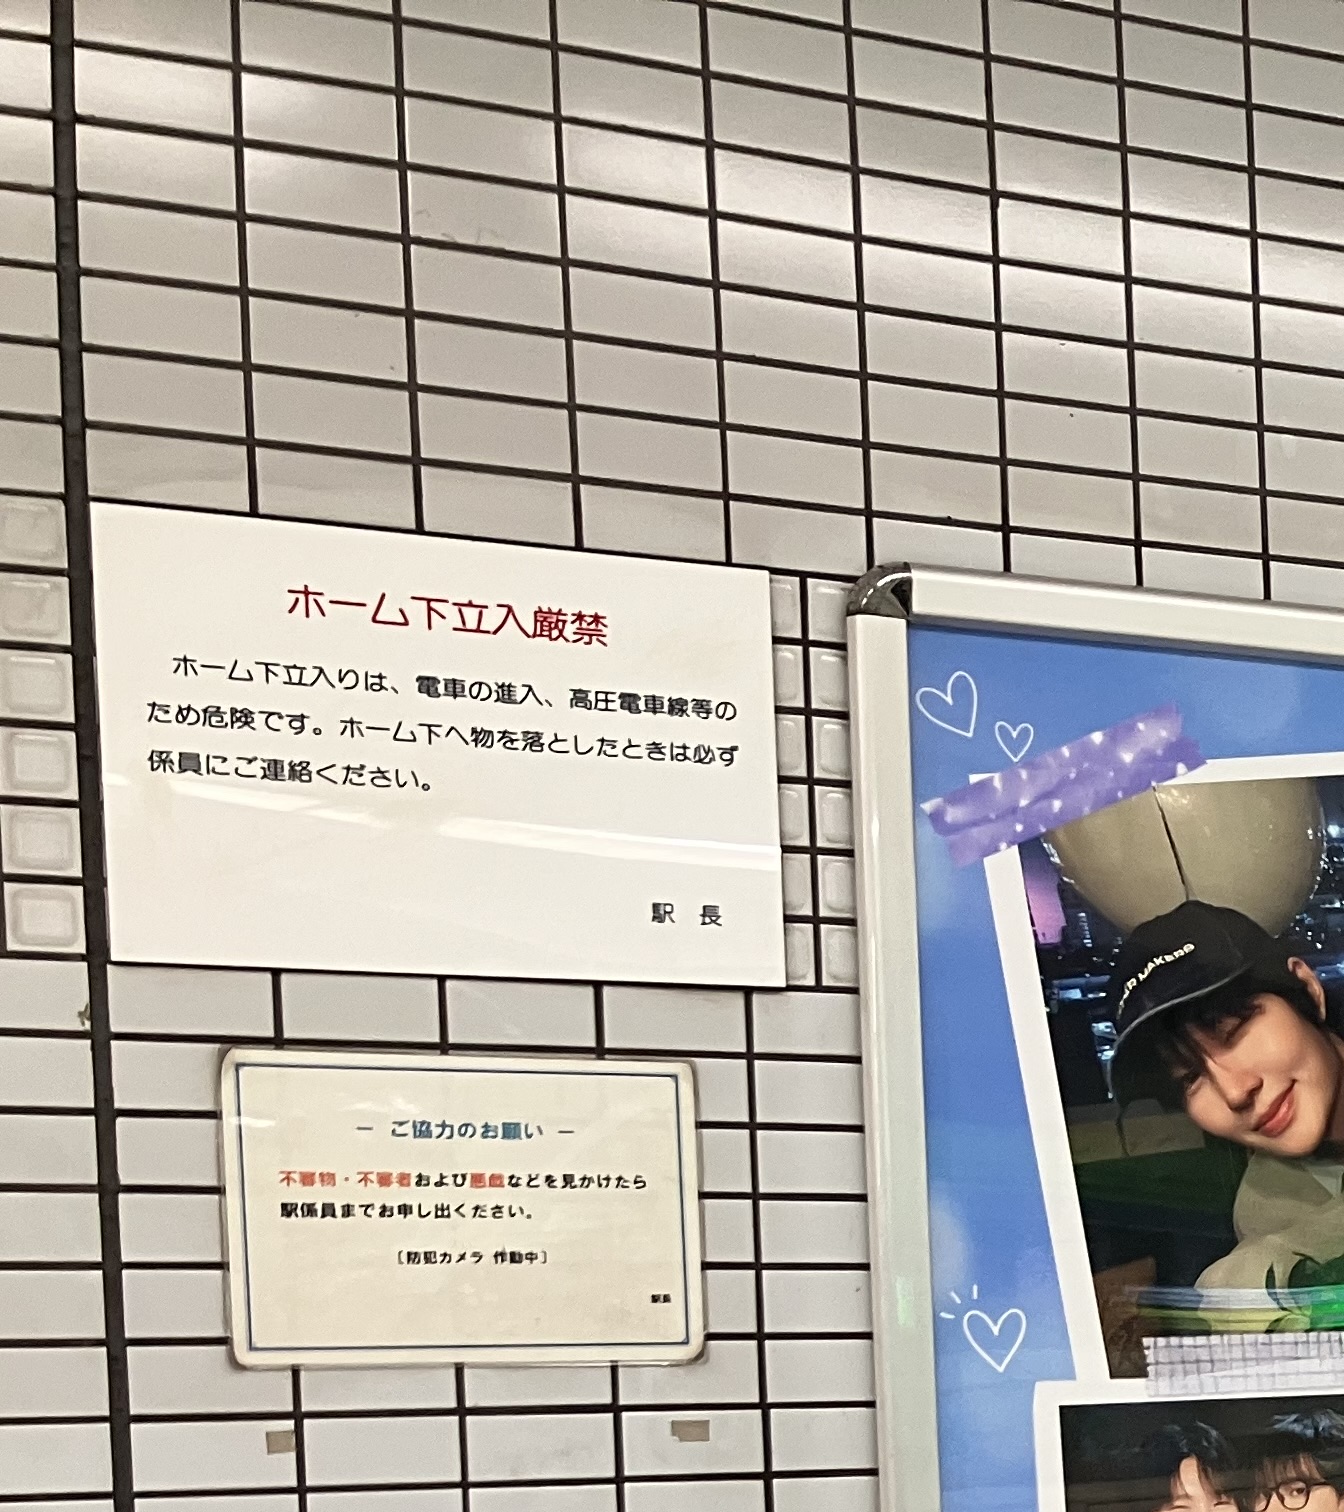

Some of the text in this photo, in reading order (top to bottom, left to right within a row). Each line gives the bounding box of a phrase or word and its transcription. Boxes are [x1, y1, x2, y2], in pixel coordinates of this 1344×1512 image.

[287, 584, 608, 647] ホーム下立入厳禁
[172, 653, 738, 721] ホーム下立入りは、電車の進入、高圧電車線等の
[147, 701, 740, 768] ため危険です。ホーム下へ物を落としたときは必ず
[147, 748, 434, 793] 係員にご連絡ください。
[391, 1120, 543, 1141] ご協力のお願い
[280, 1202, 534, 1221] 駅係員までお申し出ください。
